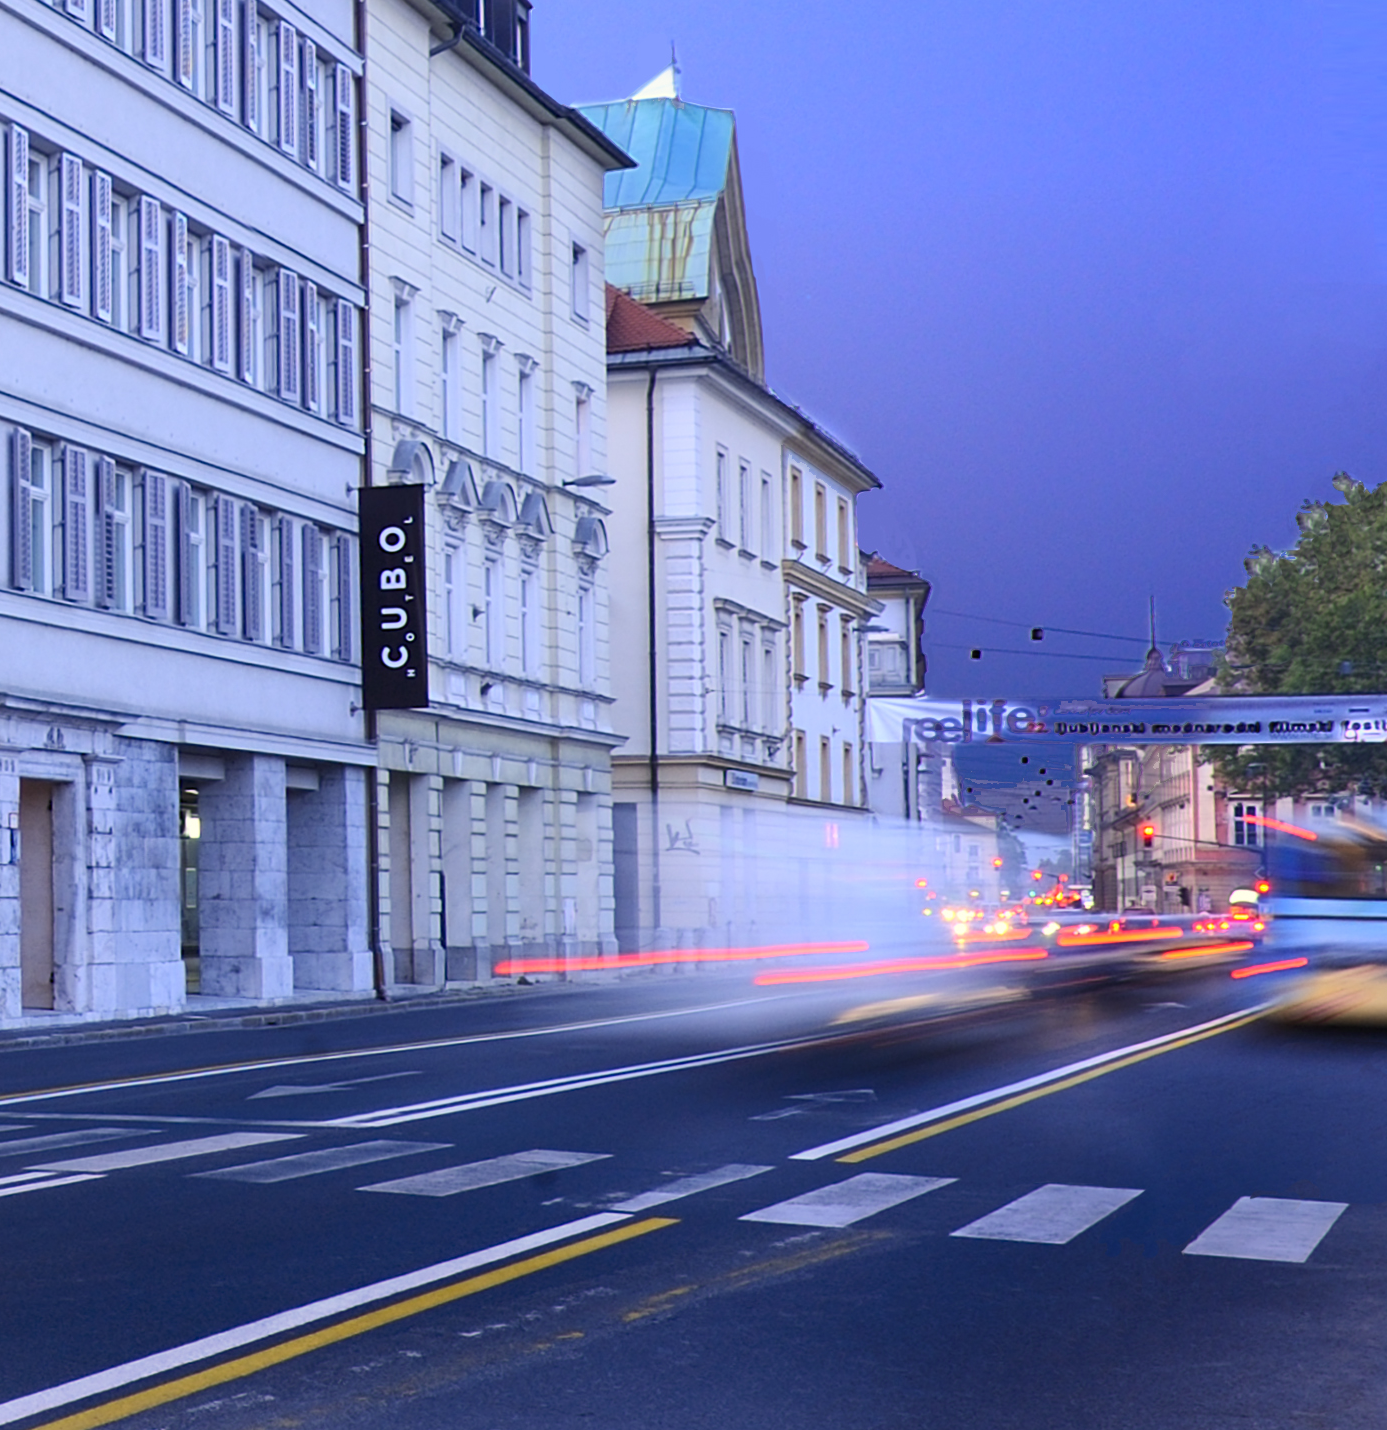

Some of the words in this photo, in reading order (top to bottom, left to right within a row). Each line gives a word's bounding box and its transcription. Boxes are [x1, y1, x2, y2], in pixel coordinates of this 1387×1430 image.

[379, 526, 409, 668] CUBO
[403, 516, 416, 677] HOTEL
[1053, 722, 1145, 735] ljubljanski
[1151, 721, 1261, 734] mednarodni
[1269, 721, 1334, 733] filmski
